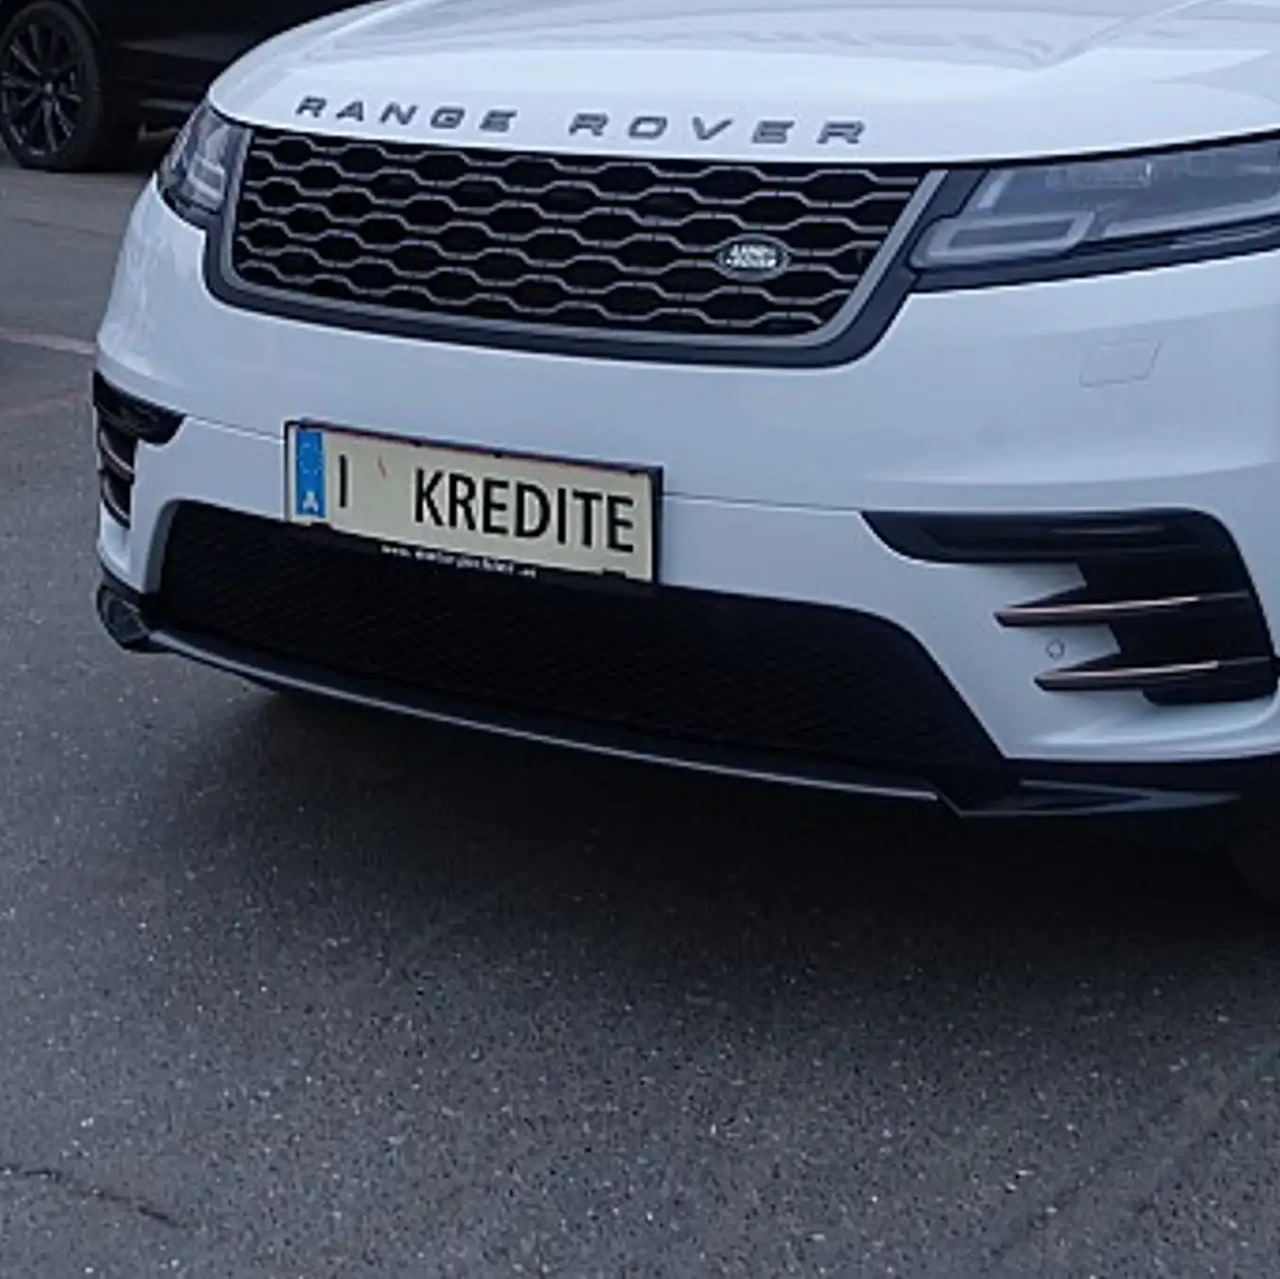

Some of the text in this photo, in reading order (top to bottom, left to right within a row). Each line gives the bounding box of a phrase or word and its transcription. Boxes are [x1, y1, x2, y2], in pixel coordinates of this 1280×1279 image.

[295, 95, 867, 146] RANGE ROVER
[414, 467, 635, 554] KREDITE
